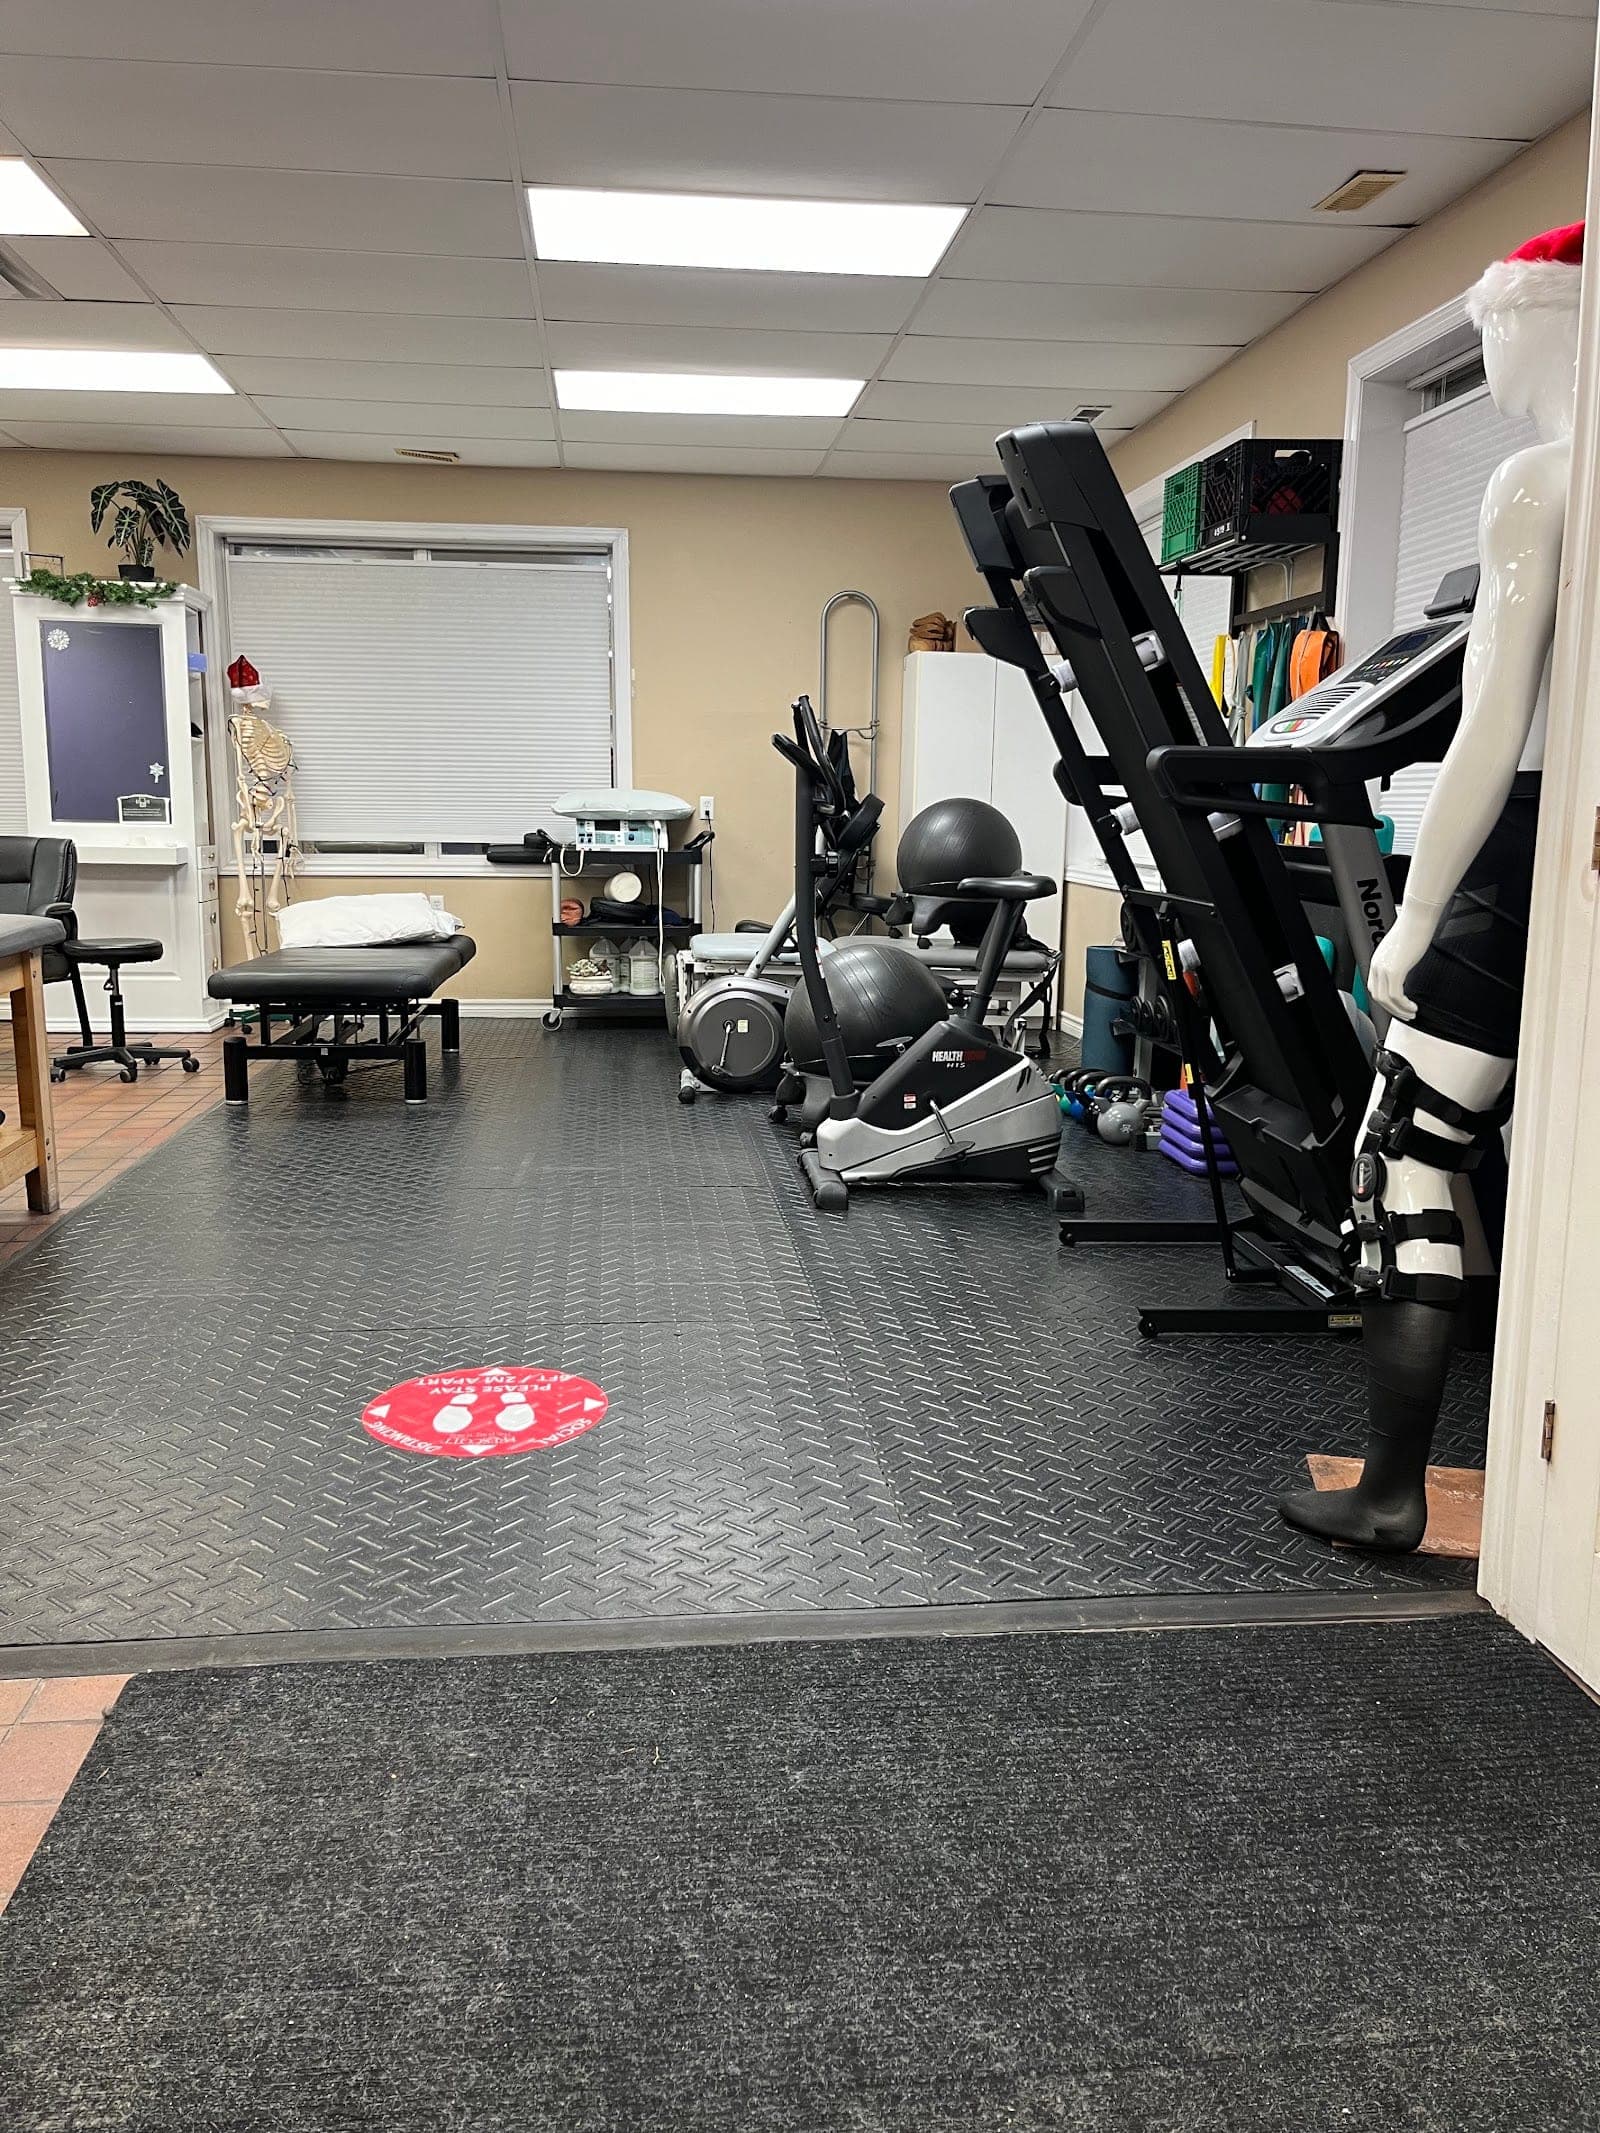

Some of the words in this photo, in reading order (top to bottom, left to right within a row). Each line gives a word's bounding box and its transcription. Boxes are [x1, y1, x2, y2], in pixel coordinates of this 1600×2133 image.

[417, 1377, 481, 1386] APART
[484, 1375, 517, 1385] 2M
[537, 1374, 574, 1383] 6FT
[428, 1386, 477, 1395] STAY
[481, 1383, 552, 1393] PLEASE
[541, 1418, 593, 1445] SOCIAL
[368, 1421, 443, 1453] DISTANCING
